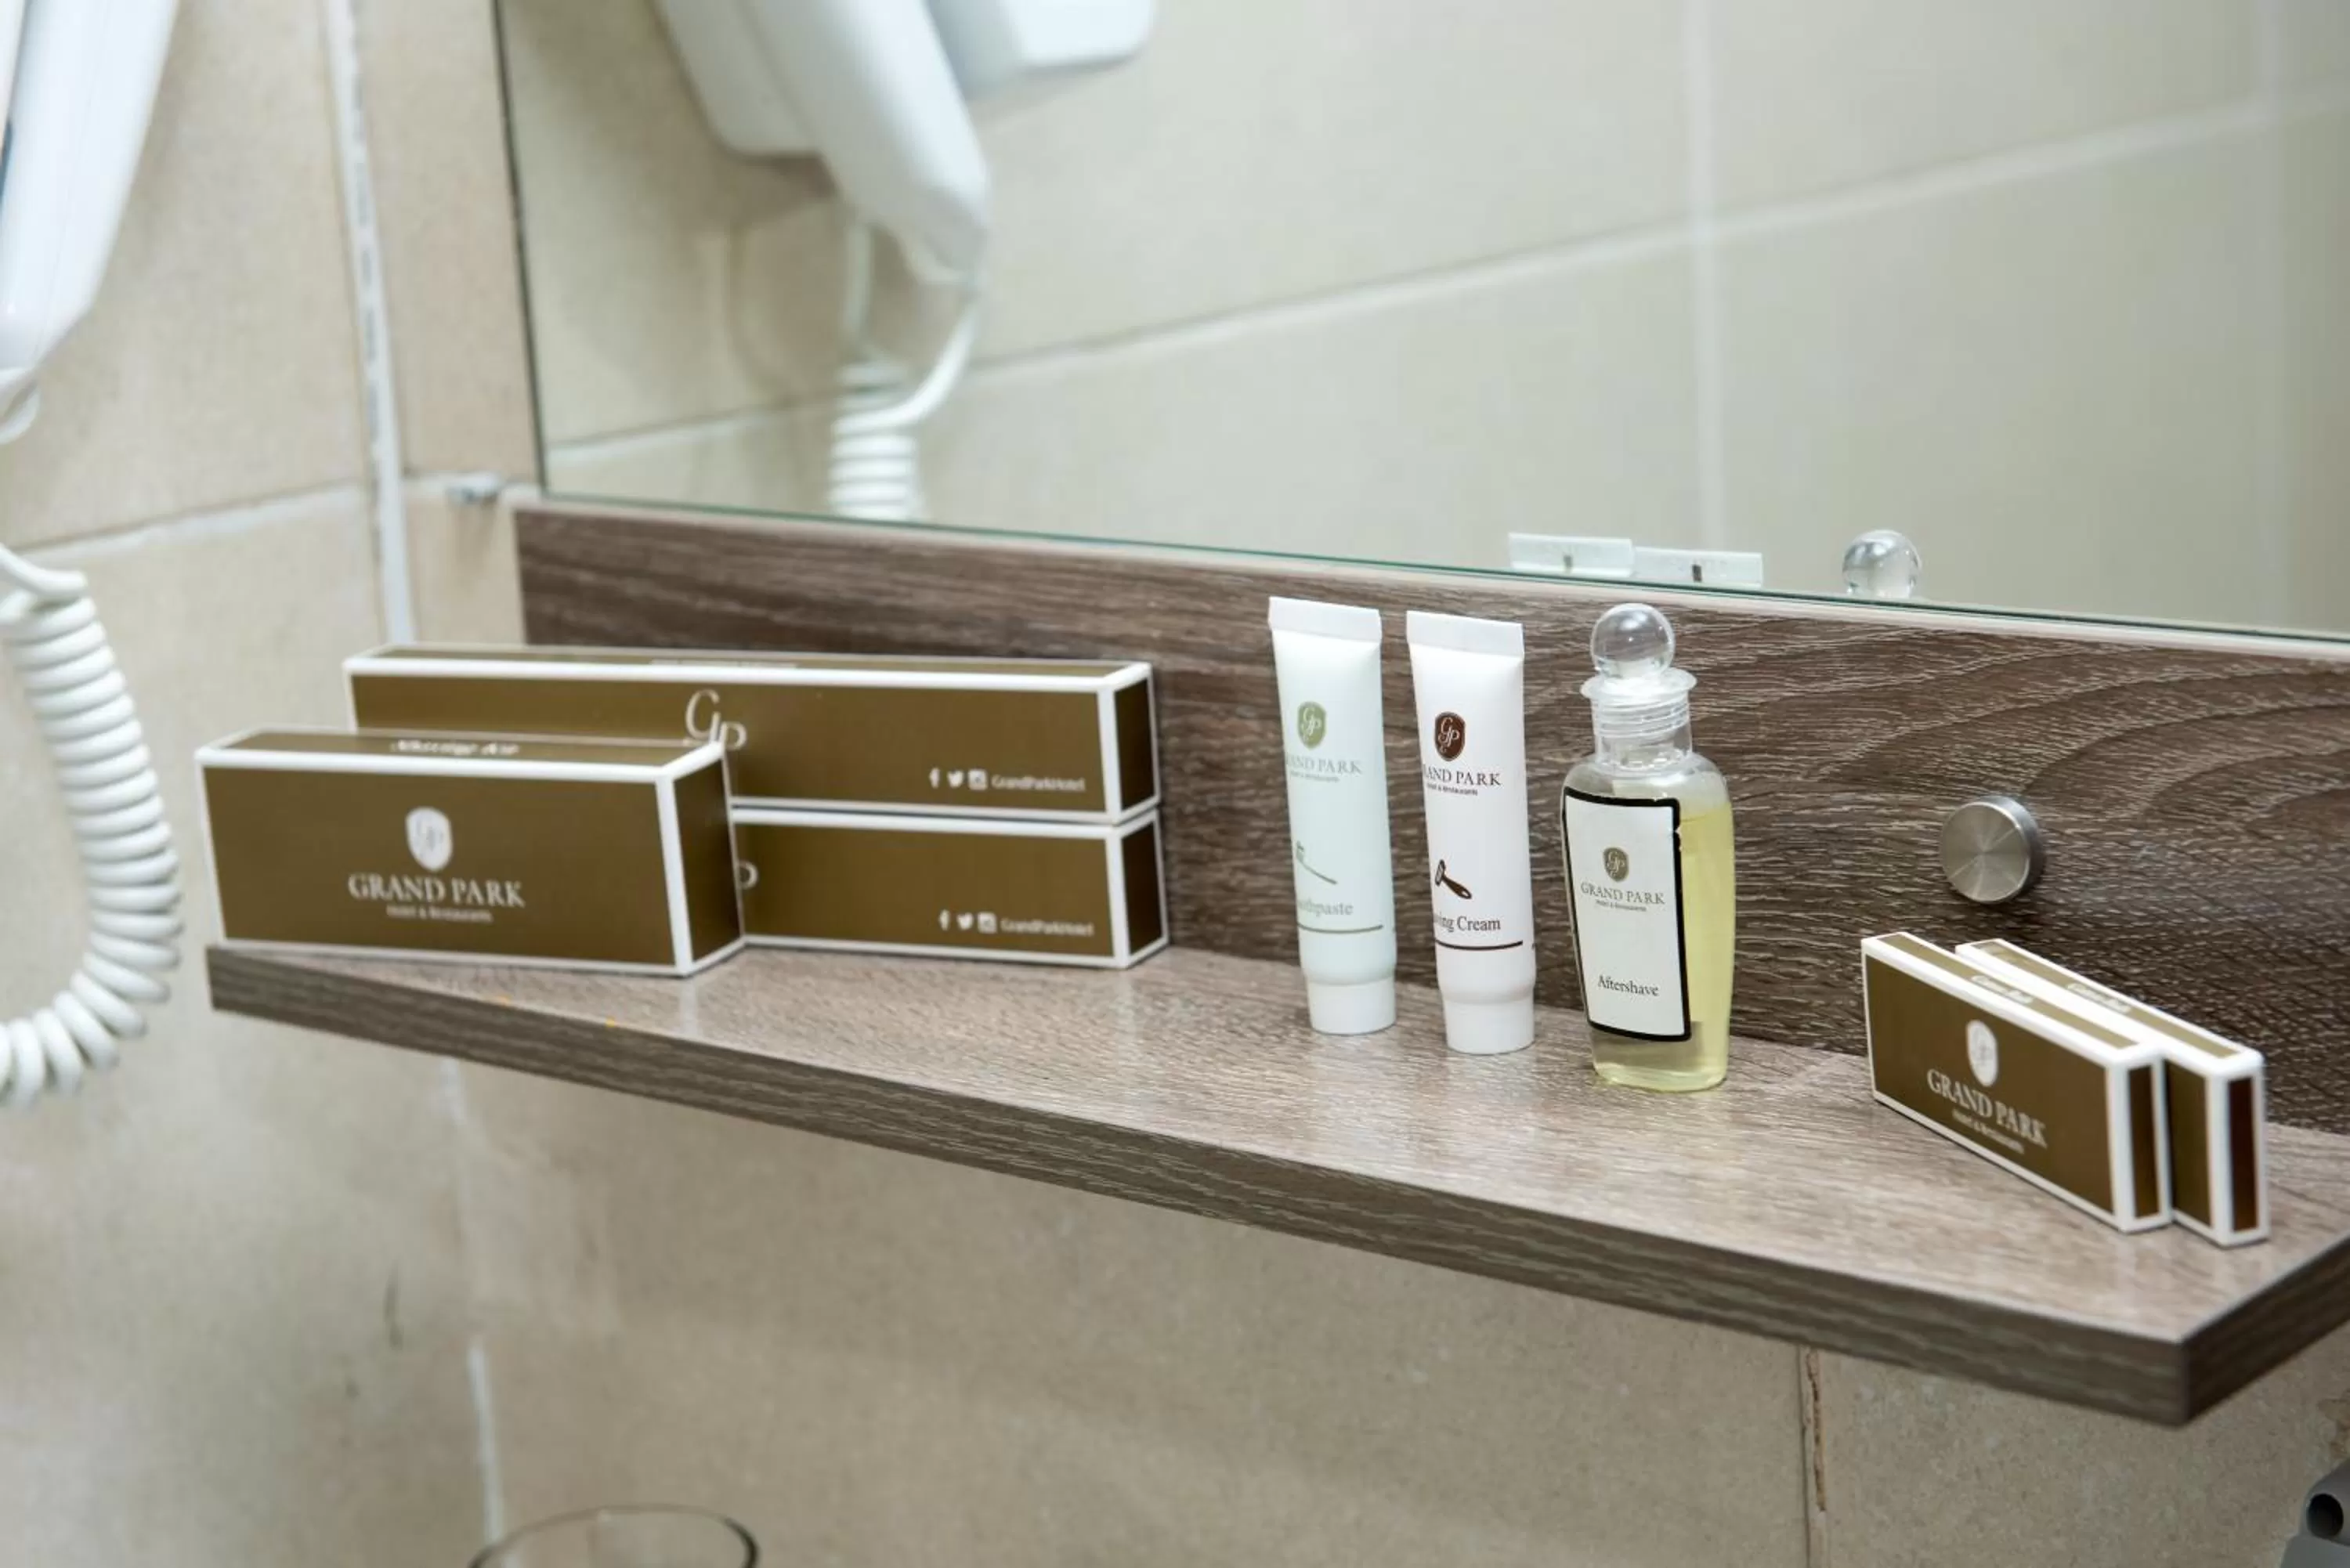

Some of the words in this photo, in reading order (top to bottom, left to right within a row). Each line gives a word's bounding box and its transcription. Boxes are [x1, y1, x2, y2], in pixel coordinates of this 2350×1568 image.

[1318, 757, 1363, 775] PARK
[1455, 770, 1502, 787] PARK
[348, 872, 446, 901] GRAND
[450, 876, 526, 909] PARK
[1580, 881, 1624, 901] GRAND
[1625, 891, 1666, 905] PARK
[1455, 915, 1502, 932] Cream
[1597, 974, 1660, 997] Aftershave
[1926, 1068, 1993, 1118] GRAND
[1994, 1100, 2048, 1150] PARK
